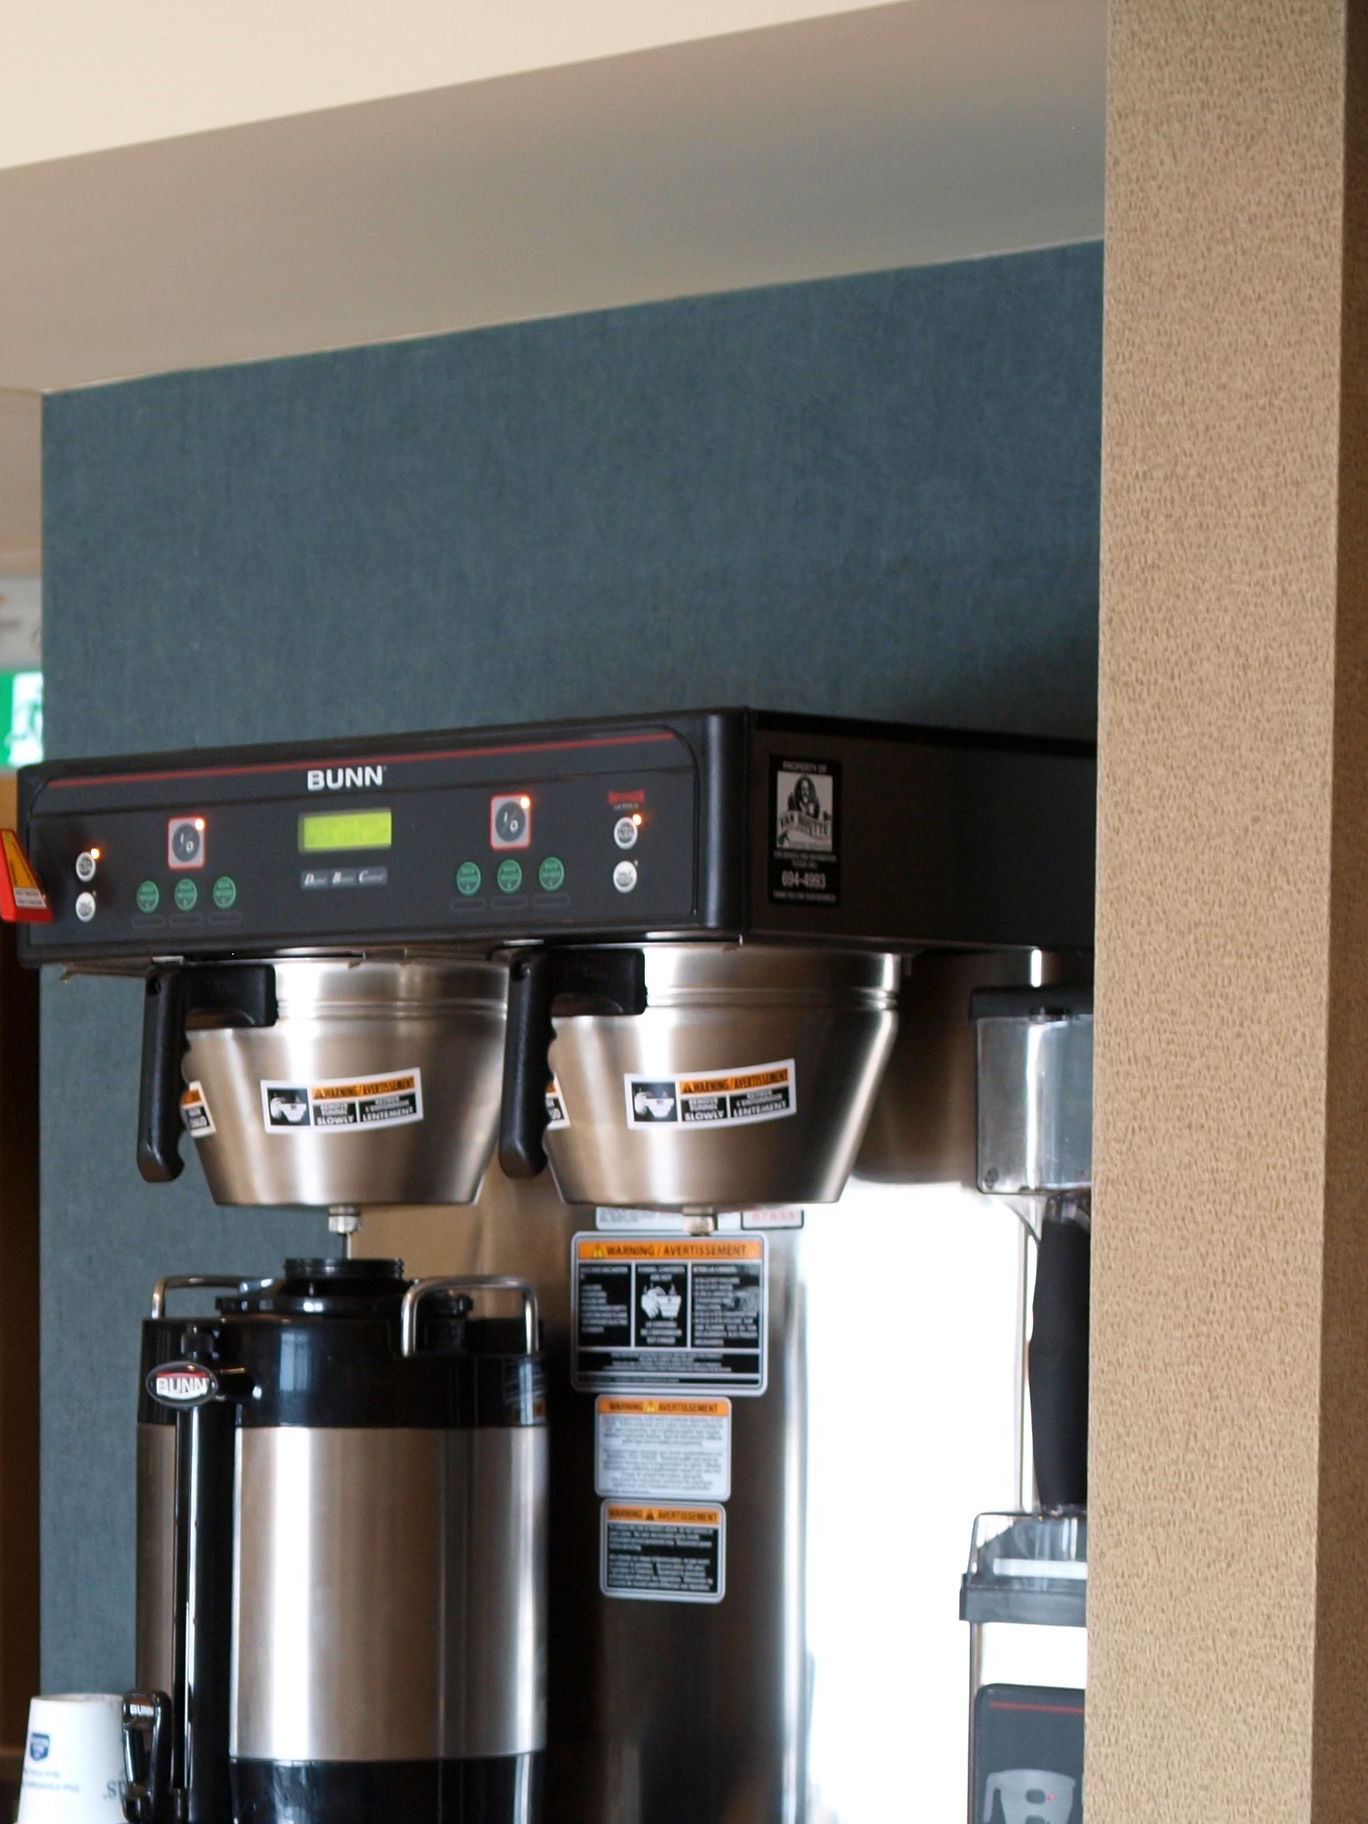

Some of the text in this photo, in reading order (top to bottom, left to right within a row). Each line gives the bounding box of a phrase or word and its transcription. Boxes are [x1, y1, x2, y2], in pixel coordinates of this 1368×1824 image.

[307, 765, 383, 791] BUNN
[316, 1115, 354, 1125] SLOWLY
[684, 1110, 724, 1121] SLOWLY
[606, 1246, 655, 1256] WARNING
[664, 1245, 747, 1257] AVERTISSEMENT
[156, 1377, 208, 1399] BUNN
[609, 1402, 719, 1412] WARNING AVERTISSEMENT
[609, 1508, 718, 1522] WARNING AVERTISSEMENT
[130, 1704, 154, 1716] BUNN
